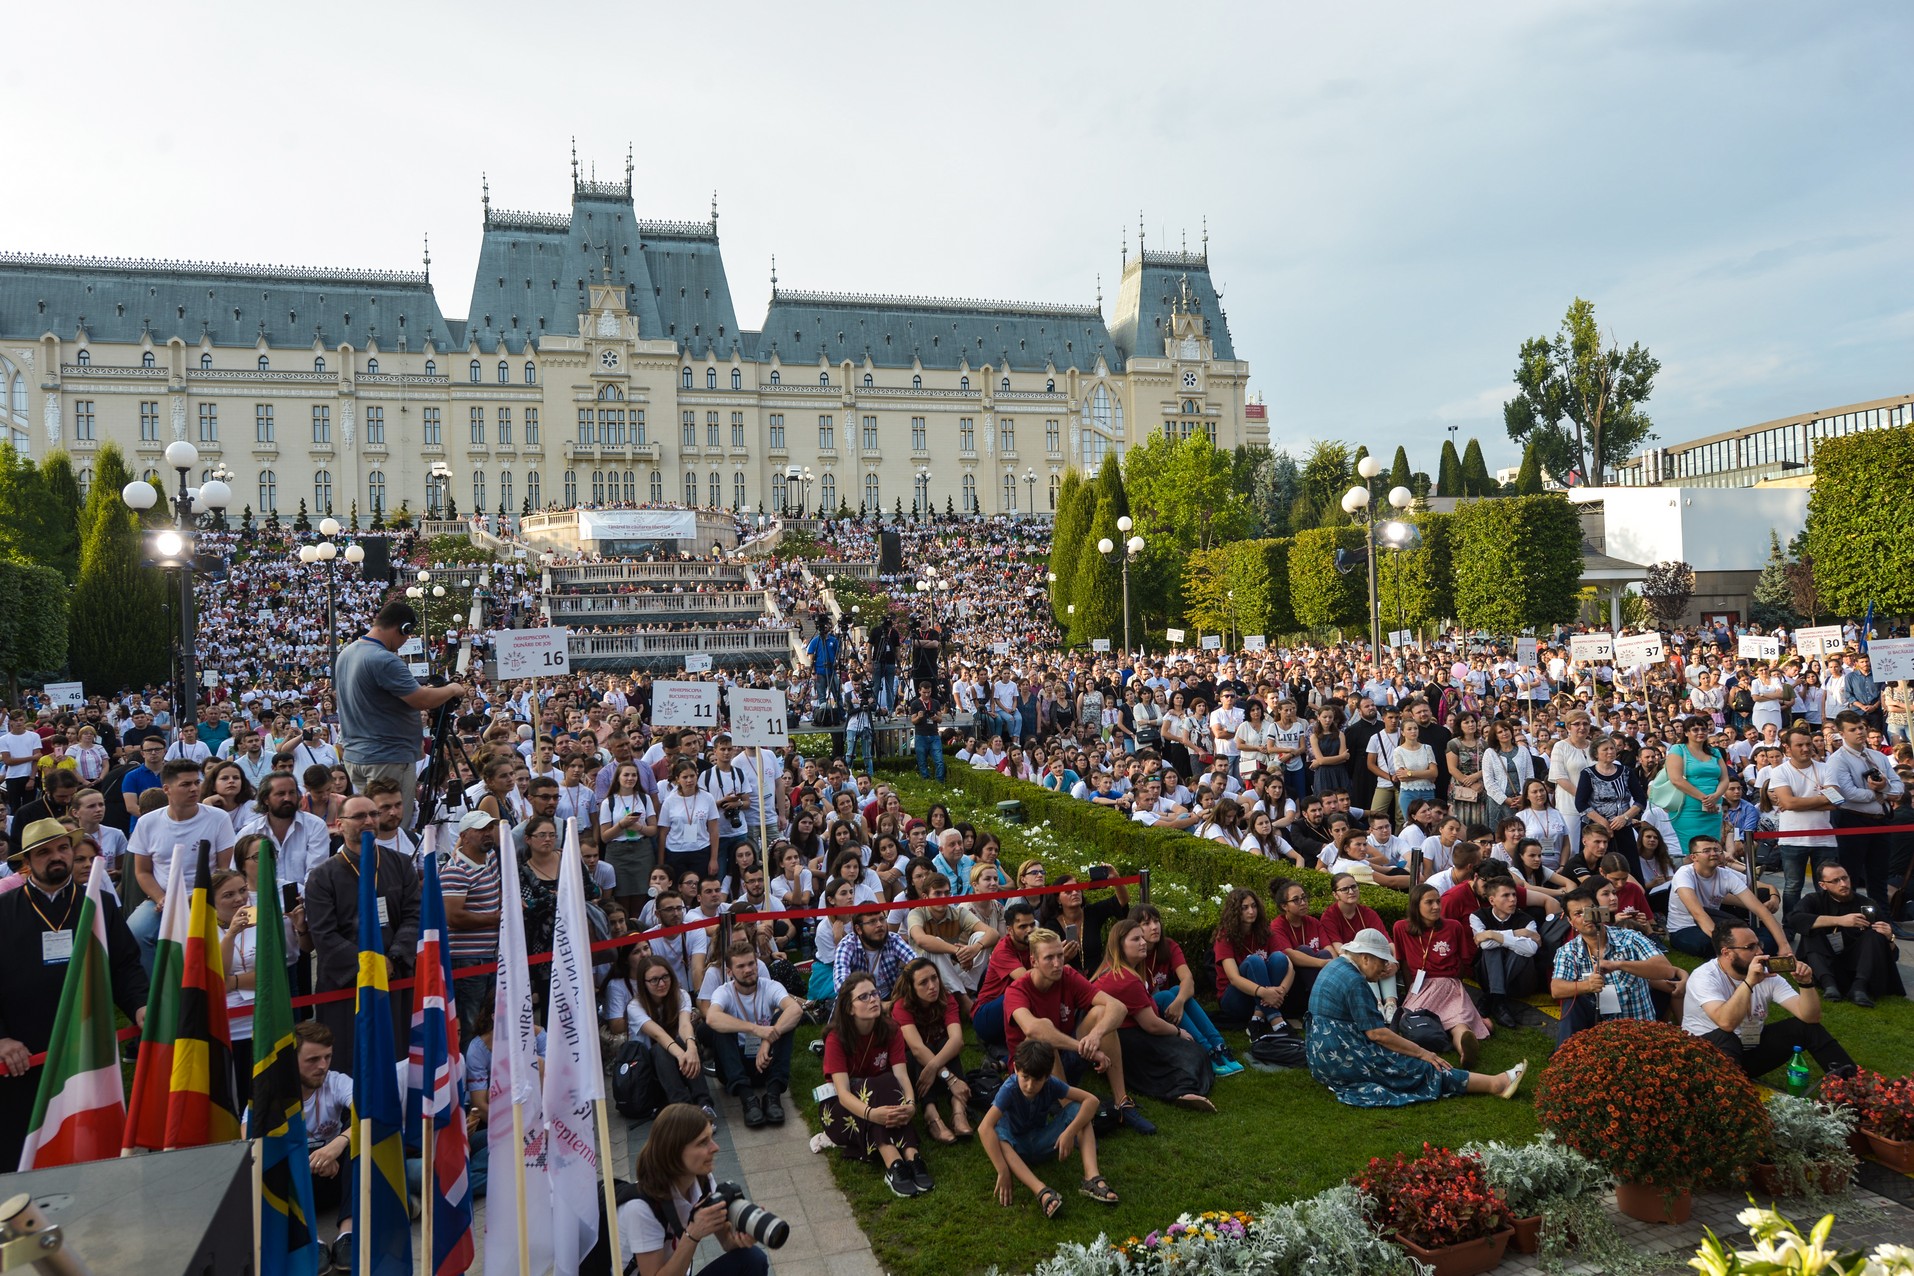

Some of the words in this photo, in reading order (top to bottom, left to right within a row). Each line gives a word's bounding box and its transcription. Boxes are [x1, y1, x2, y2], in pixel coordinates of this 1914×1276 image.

[1825, 638, 1840, 648] 30
[1596, 646, 1610, 654] 37
[1645, 646, 1659, 656] 37
[543, 650, 564, 666] 16
[1530, 652, 1536, 660] 51
[694, 704, 712, 718] 11
[766, 718, 784, 735] 11
[1279, 733, 1298, 742] LIVE
